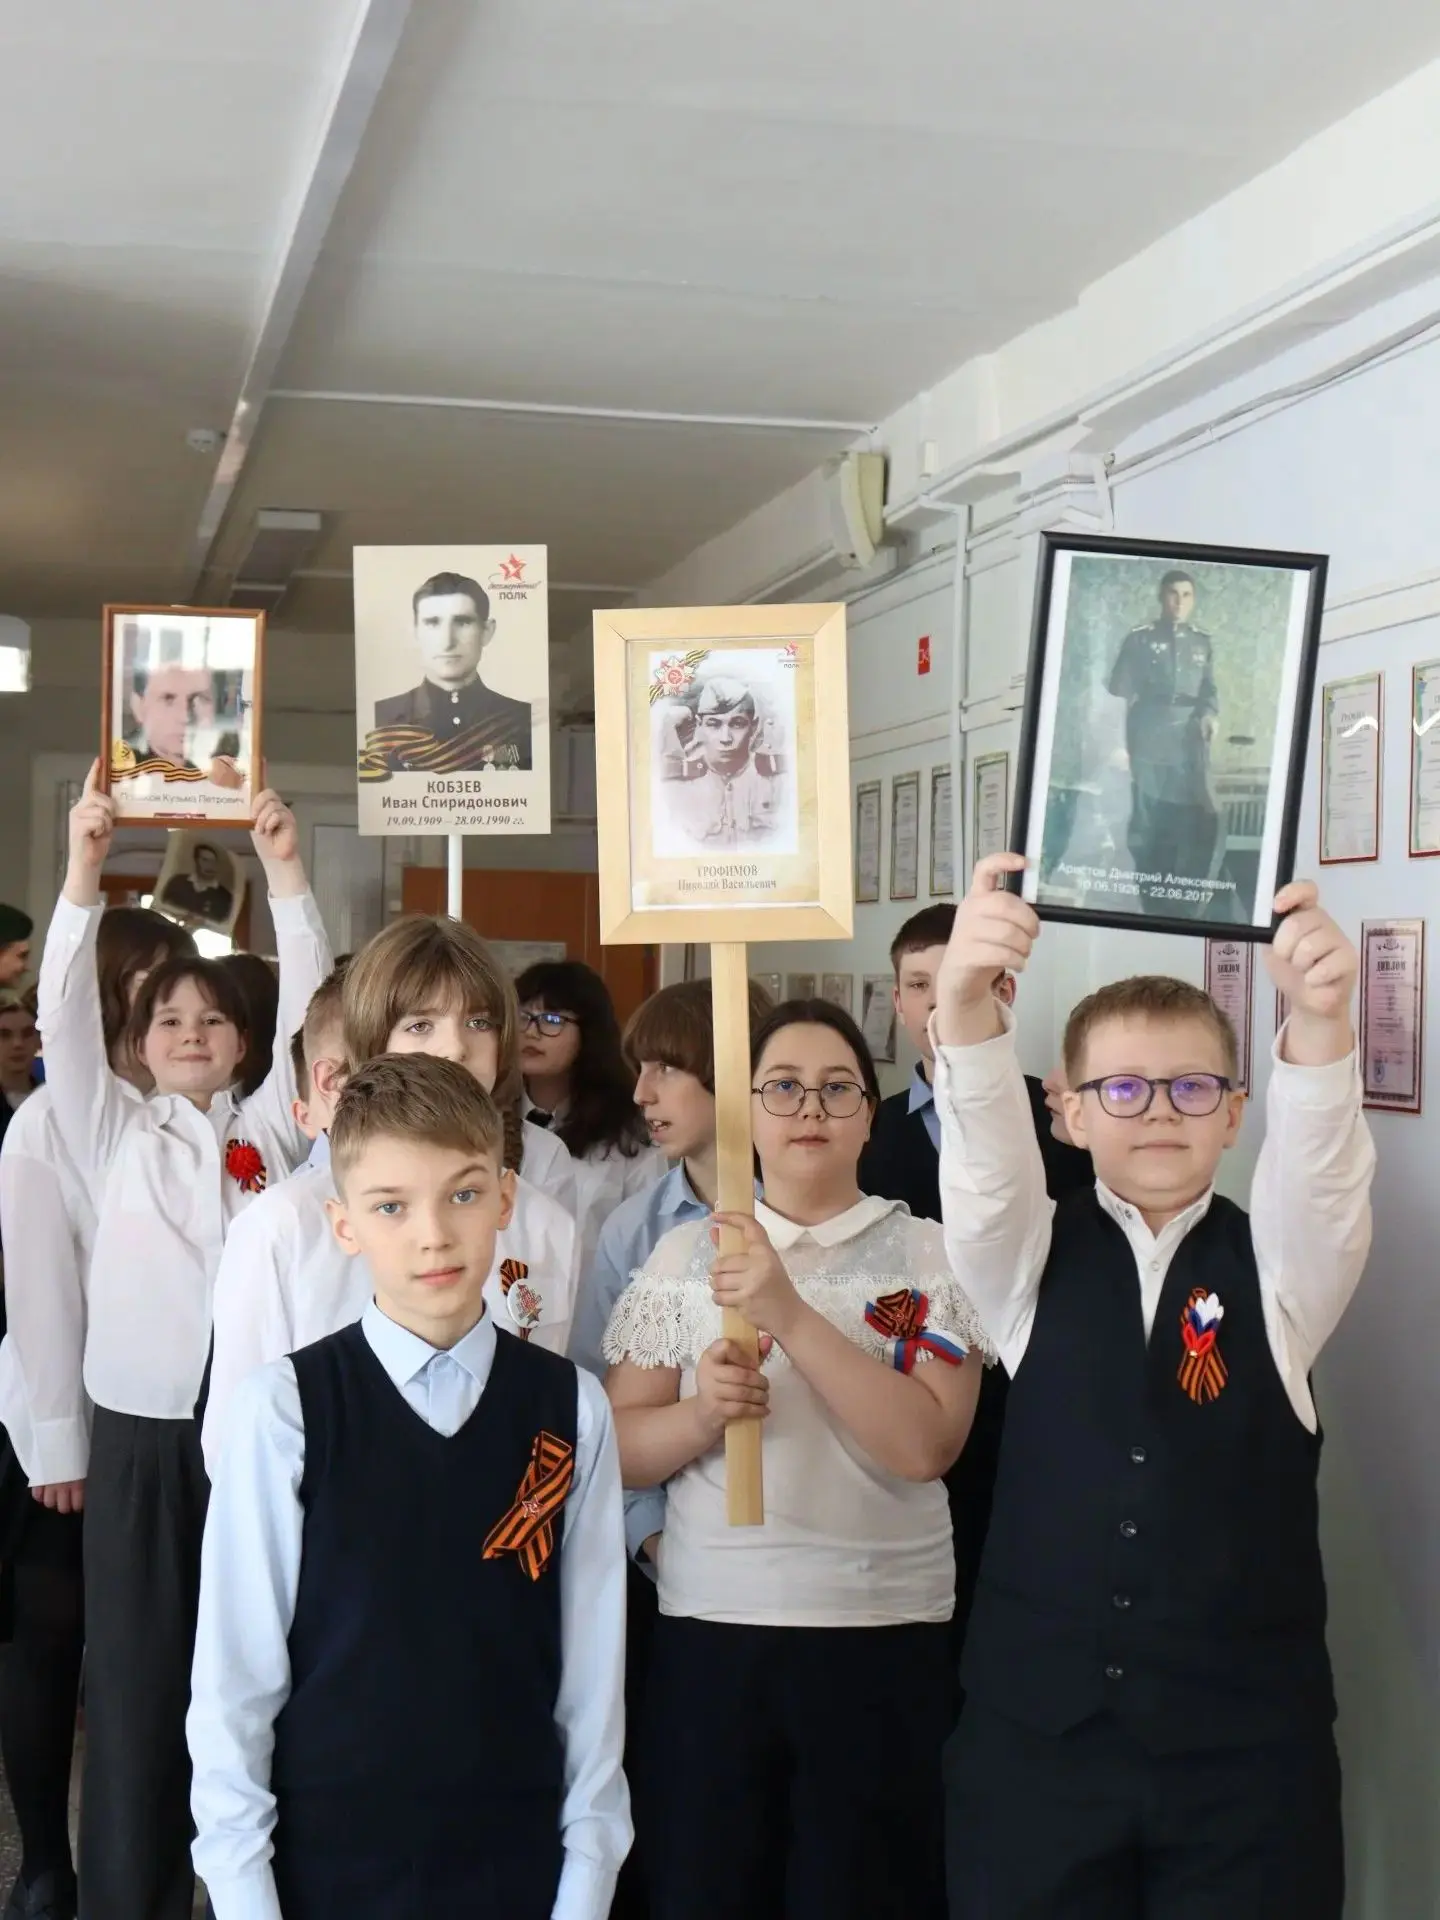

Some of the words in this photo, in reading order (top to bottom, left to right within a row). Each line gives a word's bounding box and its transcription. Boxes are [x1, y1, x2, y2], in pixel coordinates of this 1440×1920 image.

[499, 591, 528, 601] ПОЛК
[427, 780, 481, 793] КОБЗЕВ
[381, 795, 418, 808] Иван
[421, 794, 528, 811] Спиридонович
[386, 815, 443, 826] 19.09.1909
[454, 814, 511, 826] 28.09.1990
[697, 864, 759, 877] ТРОФИМОВ
[1057, 862, 1106, 879] Аристов
[1108, 867, 1163, 883] Дмитрий
[1164, 873, 1237, 890] Алексеевич
[722, 878, 777, 890] Васильевич
[1150, 886, 1214, 903] 22.06.2017
